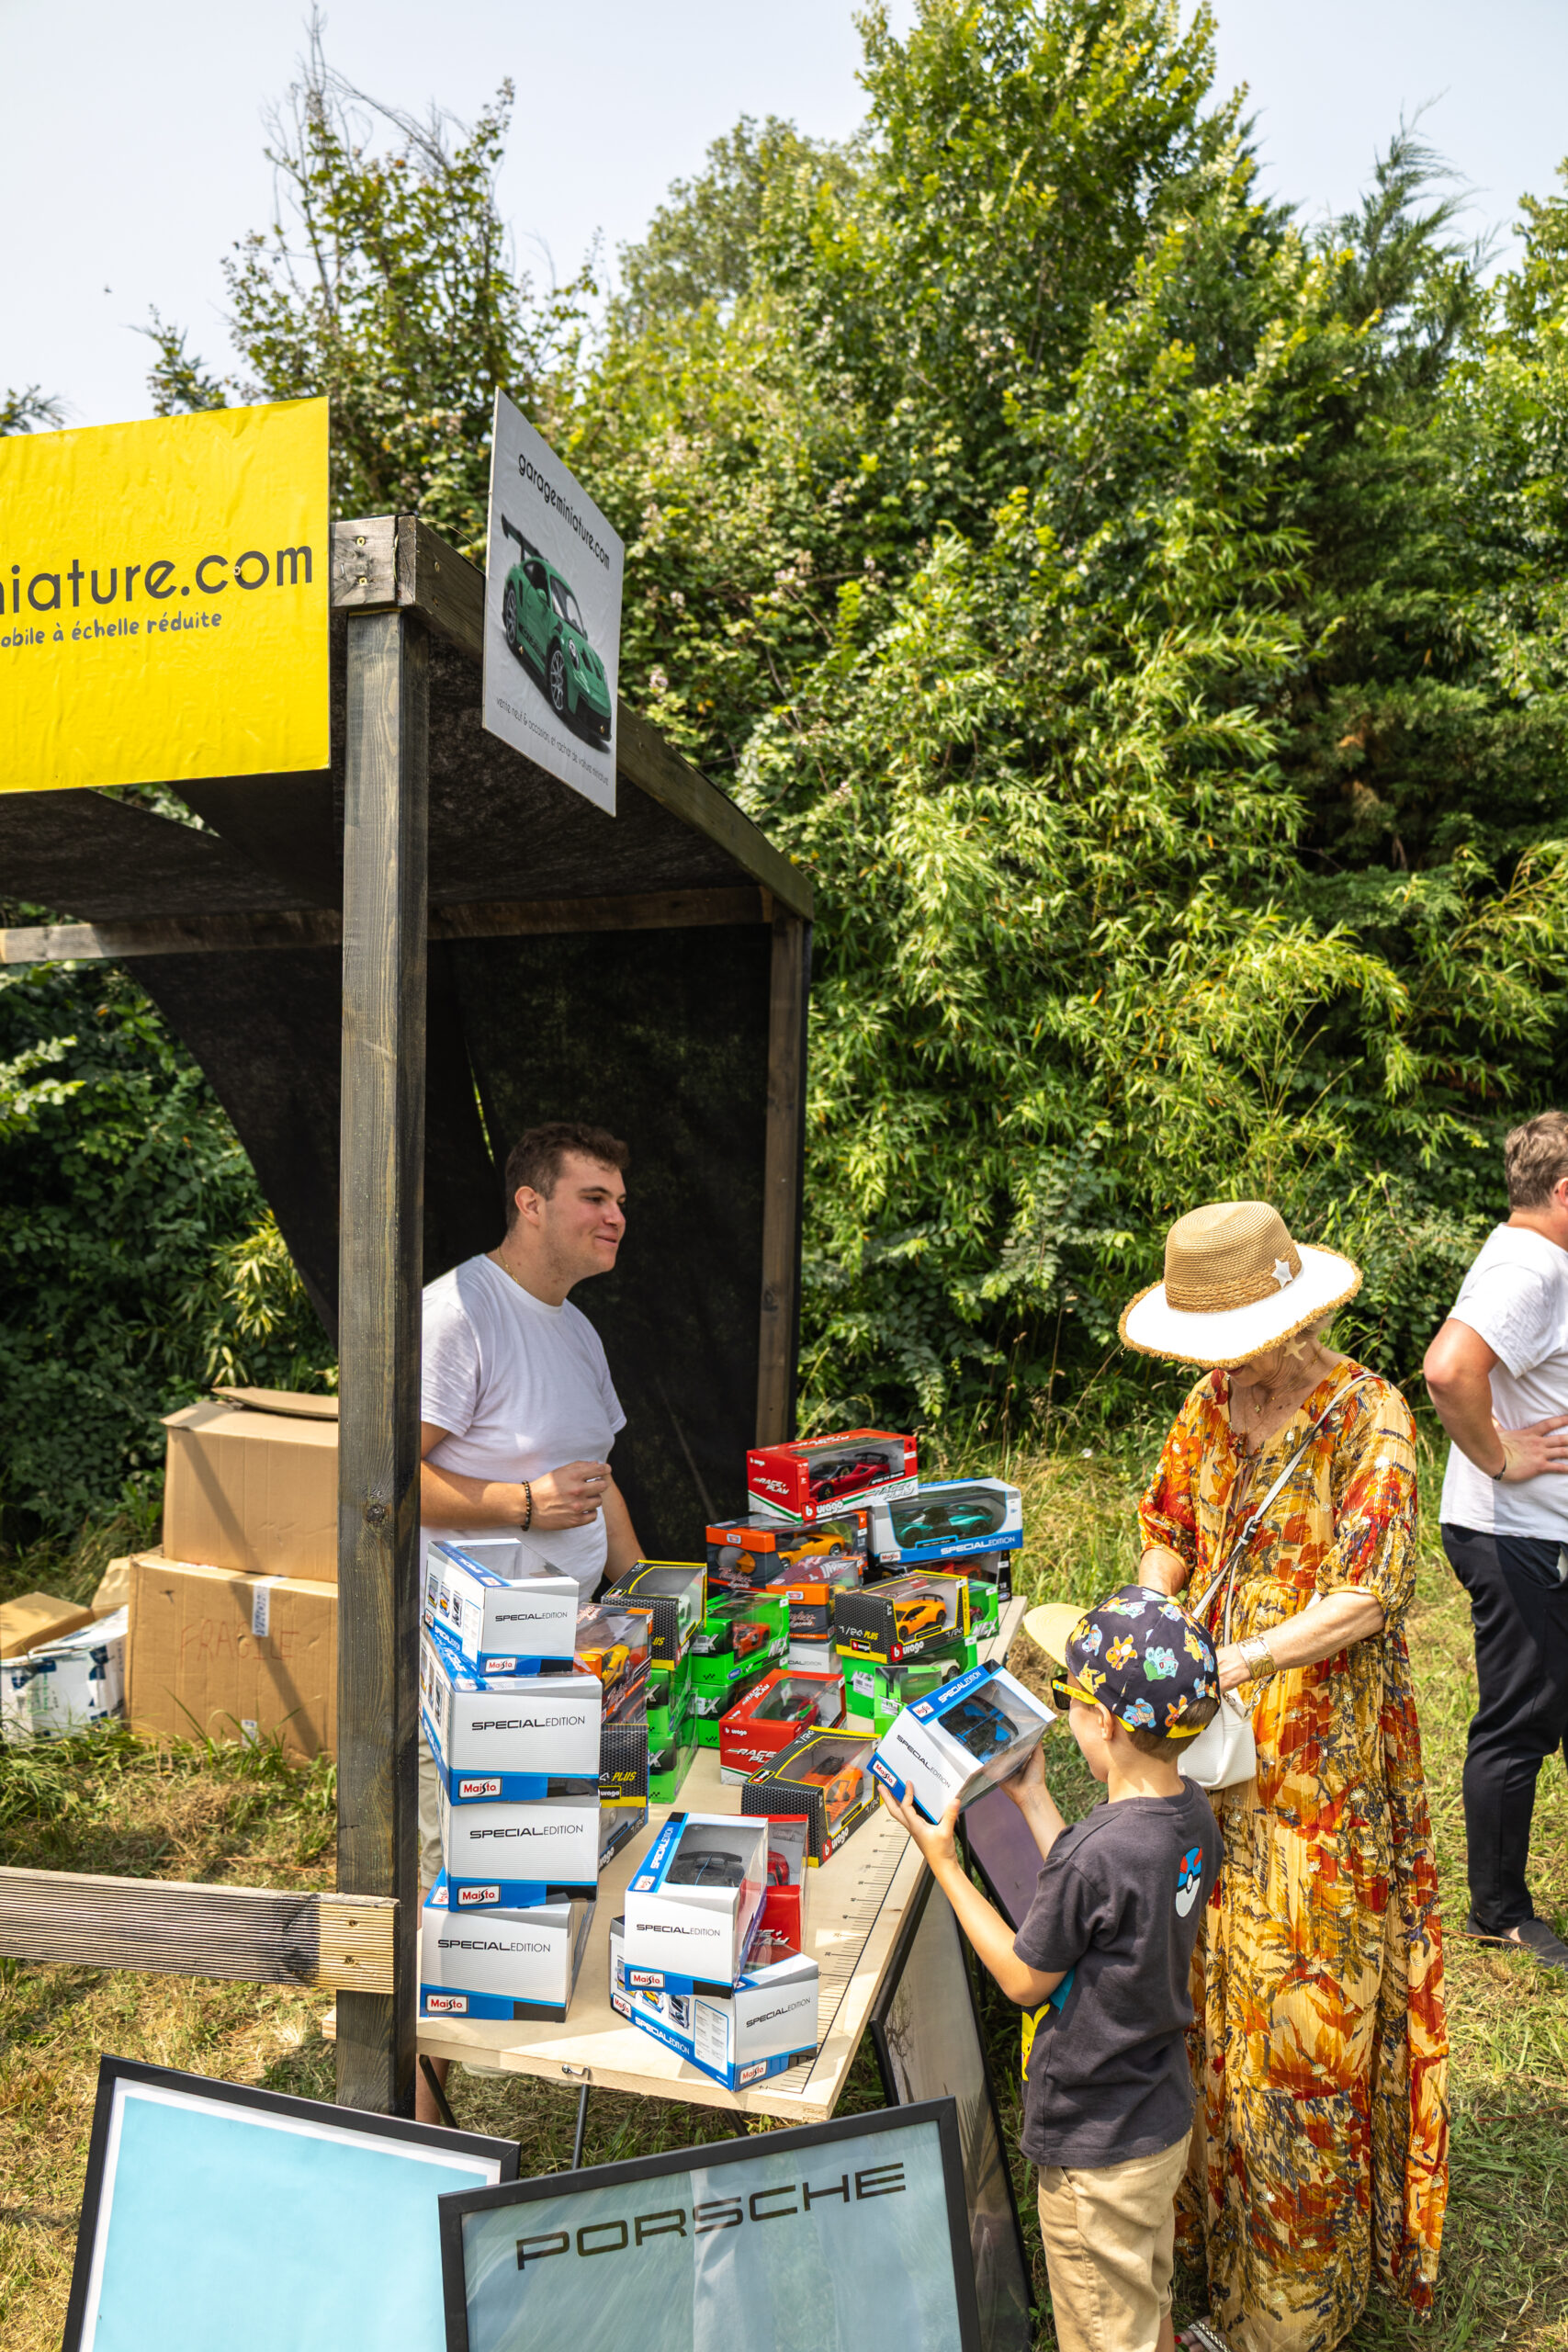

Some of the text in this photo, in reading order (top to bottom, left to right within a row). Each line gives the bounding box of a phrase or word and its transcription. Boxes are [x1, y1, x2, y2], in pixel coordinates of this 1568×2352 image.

[518, 453, 610, 571] garageminiature.com
[52, 622, 64, 641] à
[72, 617, 139, 641] échelle
[147, 610, 222, 634] réduite
[180, 1619, 300, 1669] FRAGILE
[489, 1658, 513, 1670] Maisto
[612, 1772, 637, 1781] PLUS
[875, 1764, 894, 1784] Maisto
[463, 1780, 497, 1795] Maisto
[463, 1889, 495, 1902] Maisto
[633, 1973, 660, 1985] Maisto
[431, 1997, 463, 2010] Maisto
[615, 1997, 630, 2014] Maisto
[742, 2065, 764, 2081] Maisto
[516, 2162, 907, 2270] PORSCHE
